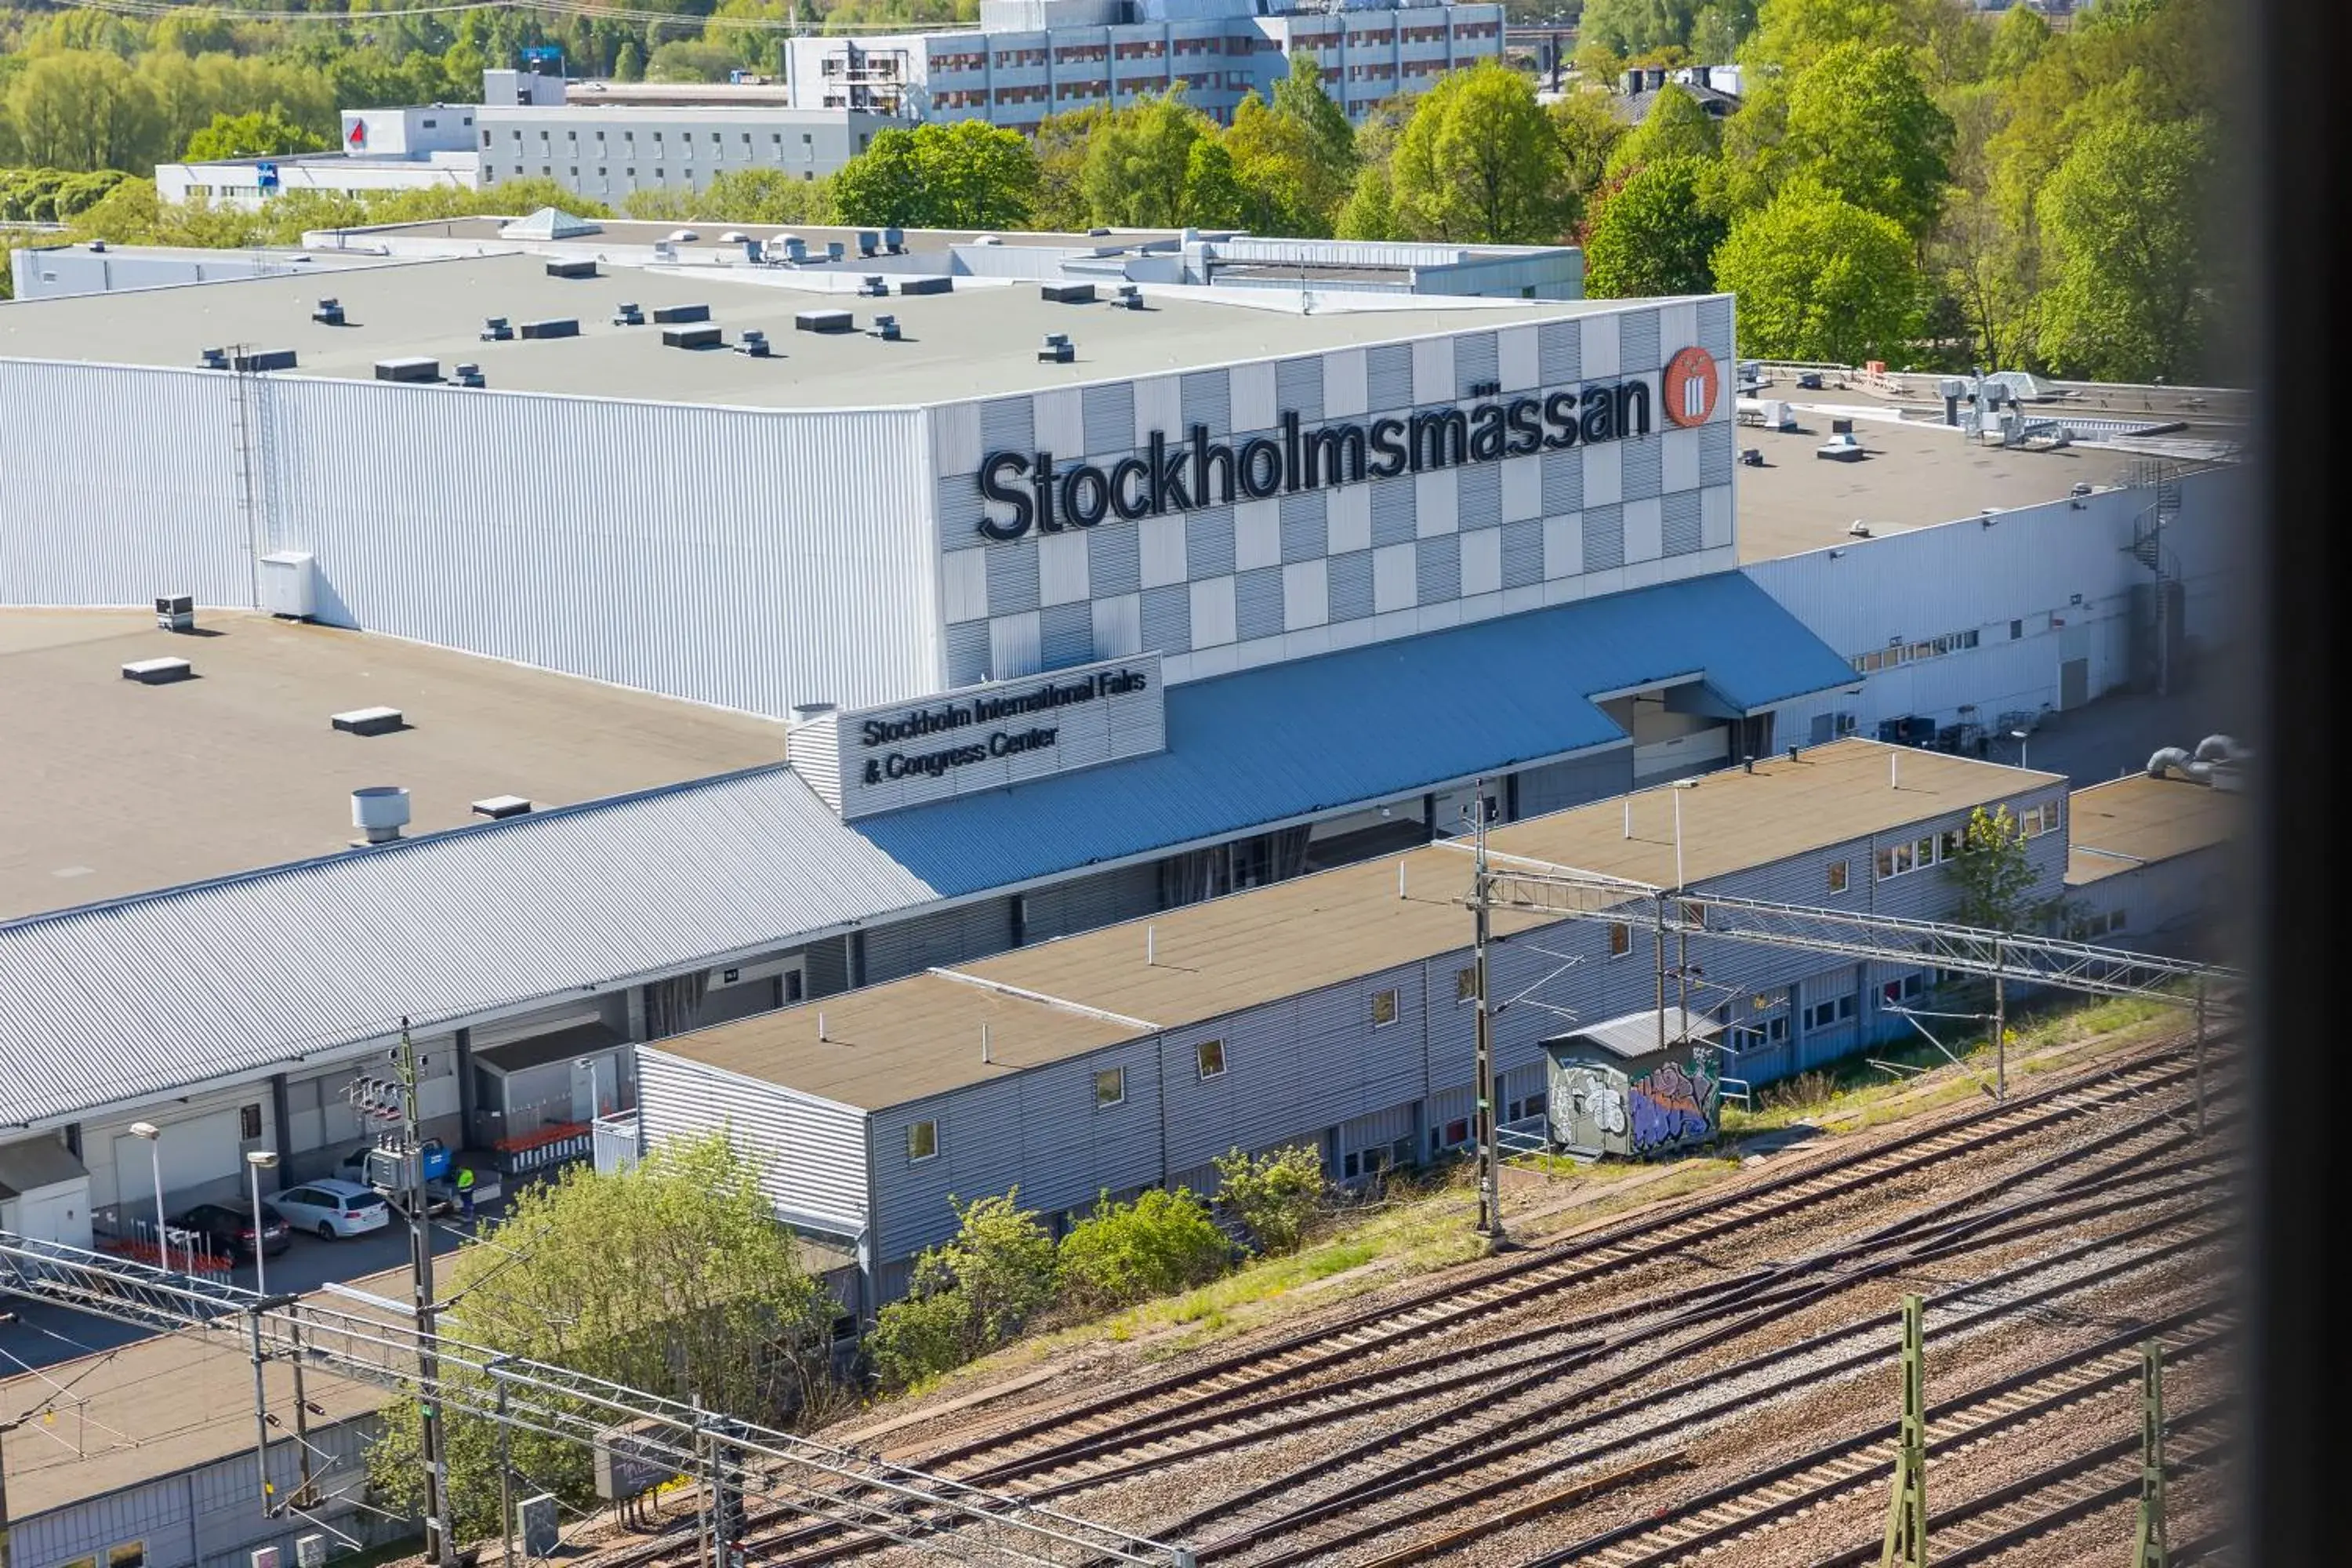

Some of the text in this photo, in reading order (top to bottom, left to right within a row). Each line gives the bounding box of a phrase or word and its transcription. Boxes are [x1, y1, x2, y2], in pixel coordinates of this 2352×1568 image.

[978, 379, 1650, 541] Stockholmsmässan
[863, 669, 1147, 746] Stockholm International Fairs
[865, 728, 1059, 784] & Congress Center
